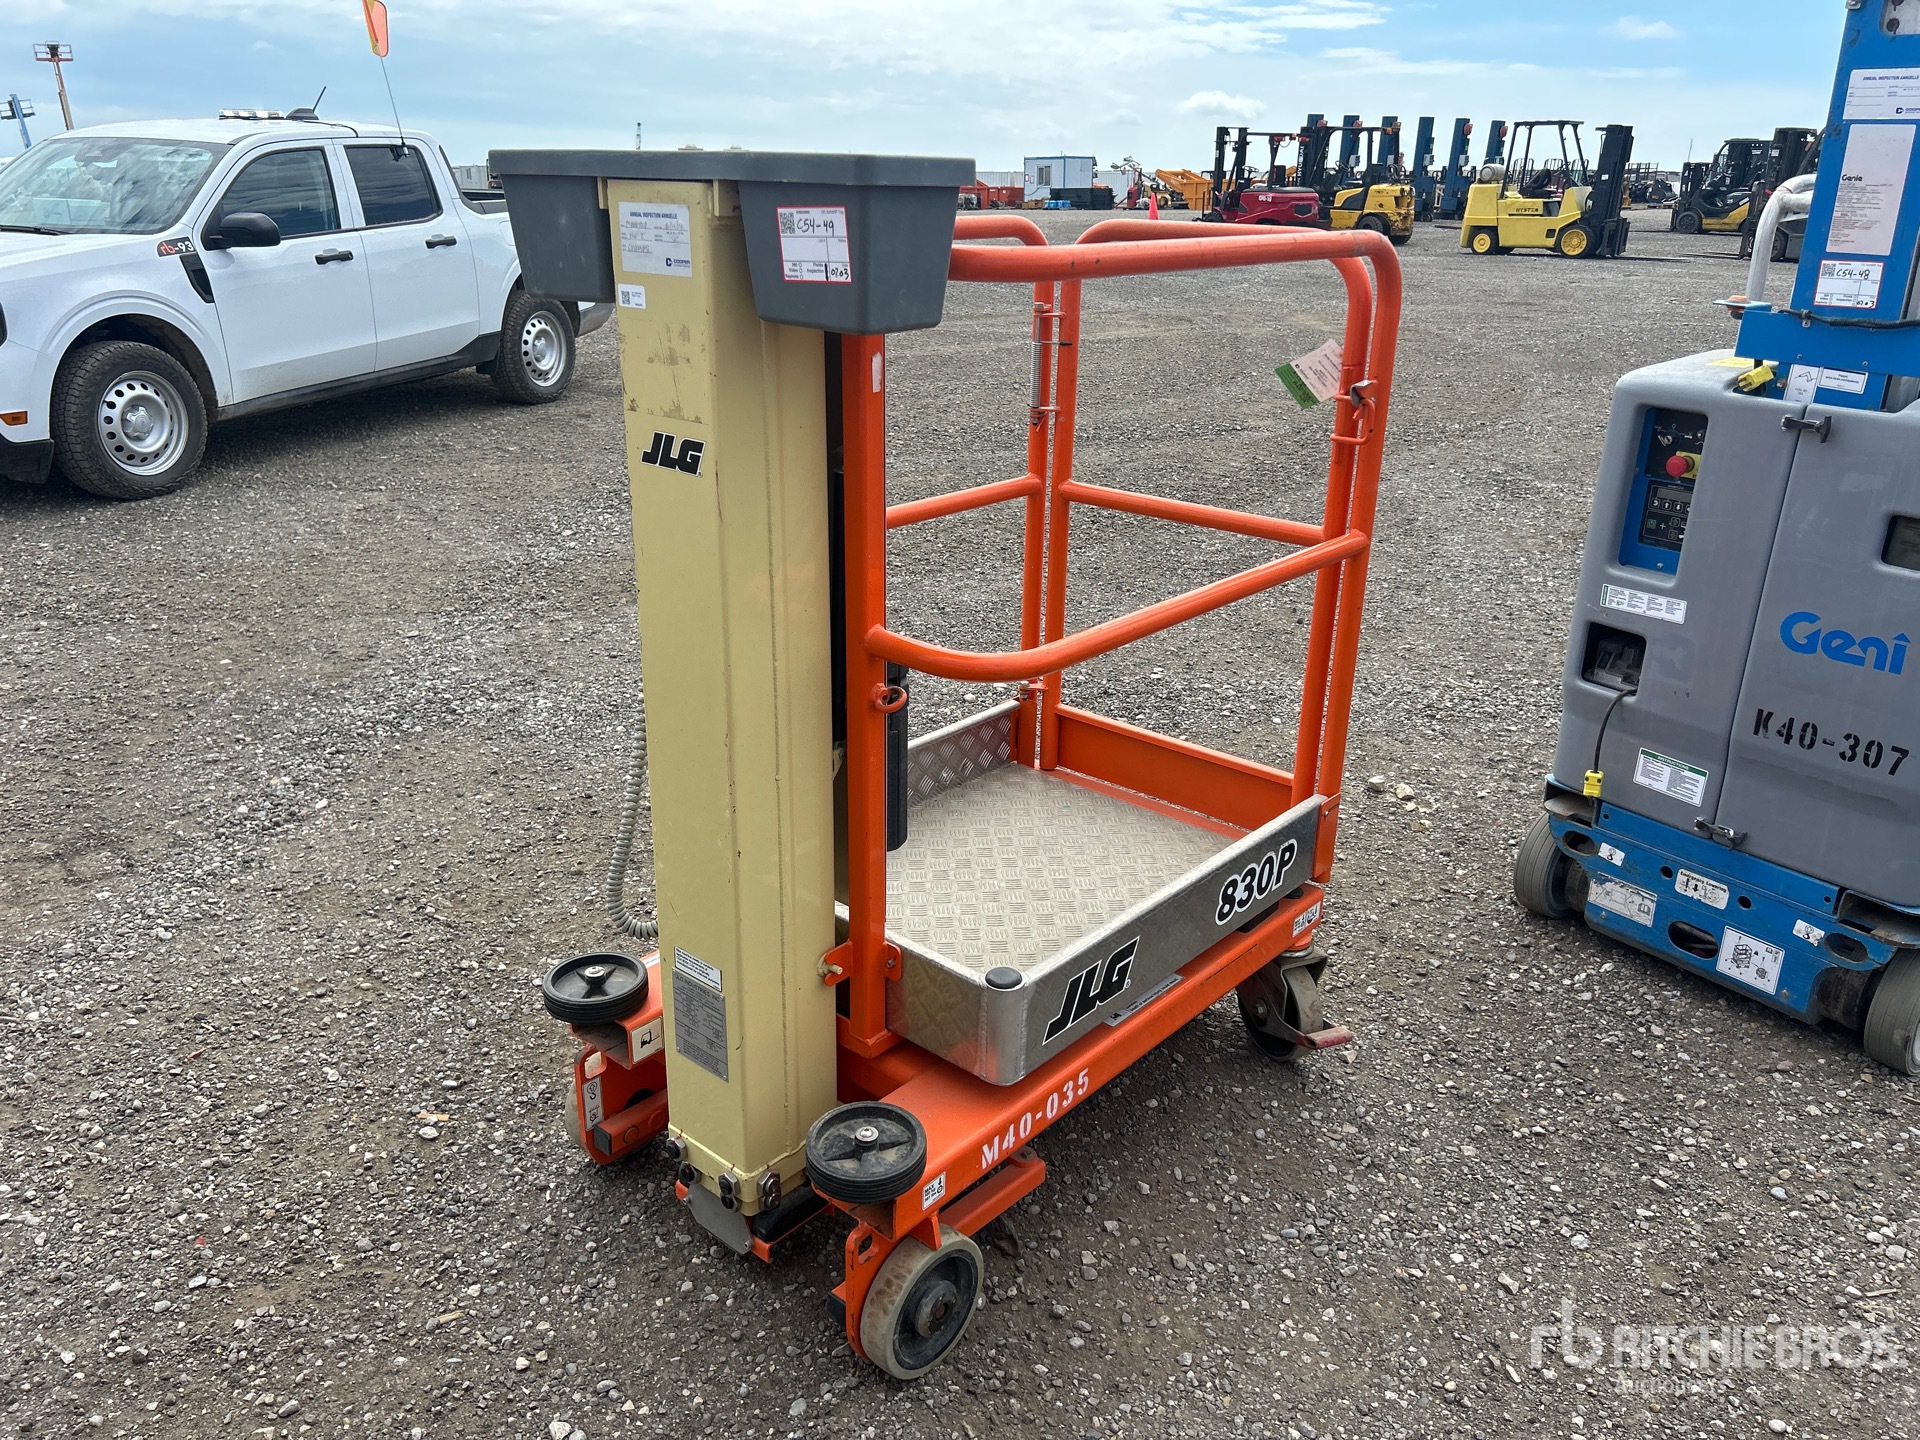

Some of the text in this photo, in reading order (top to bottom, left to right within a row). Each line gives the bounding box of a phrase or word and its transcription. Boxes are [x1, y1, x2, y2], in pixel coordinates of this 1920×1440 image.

[797, 218, 834, 237] C54-49
[160, 241, 194, 254] rb-93
[1836, 269, 1870, 280] C54-48
[641, 431, 704, 475] JLG
[1753, 708, 1910, 776] K40-307
[1216, 839, 1298, 924] 830P
[1706, 880, 1727, 893] Lowering
[1042, 936, 1140, 1045] JLG
[982, 1068, 1089, 1169] M40-035
[925, 1184, 934, 1193] MAX
